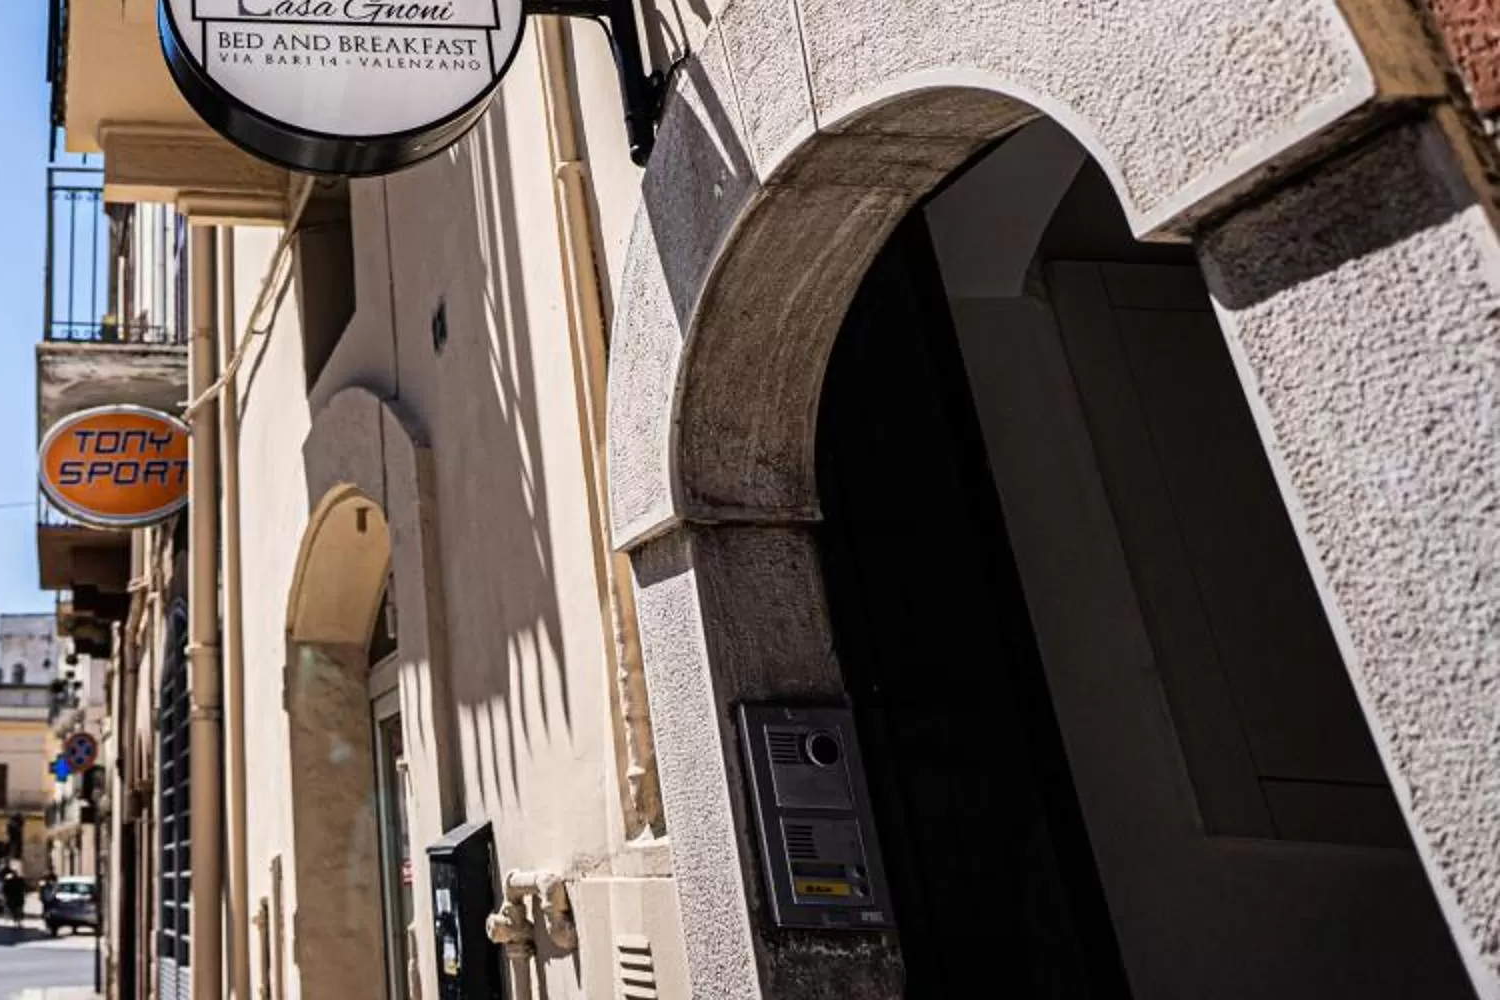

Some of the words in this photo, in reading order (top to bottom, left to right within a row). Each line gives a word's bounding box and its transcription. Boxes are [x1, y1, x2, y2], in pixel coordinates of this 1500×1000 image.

[218, 31, 264, 49] BED
[273, 34, 331, 51] AND
[339, 35, 477, 55] BREAKFAST
[219, 52, 253, 64] VIA
[265, 53, 311, 65] BARI
[320, 55, 337, 67] 14
[359, 57, 481, 71] VALENZANO
[75, 431, 173, 453] TONY
[59, 461, 189, 485] SPORT
